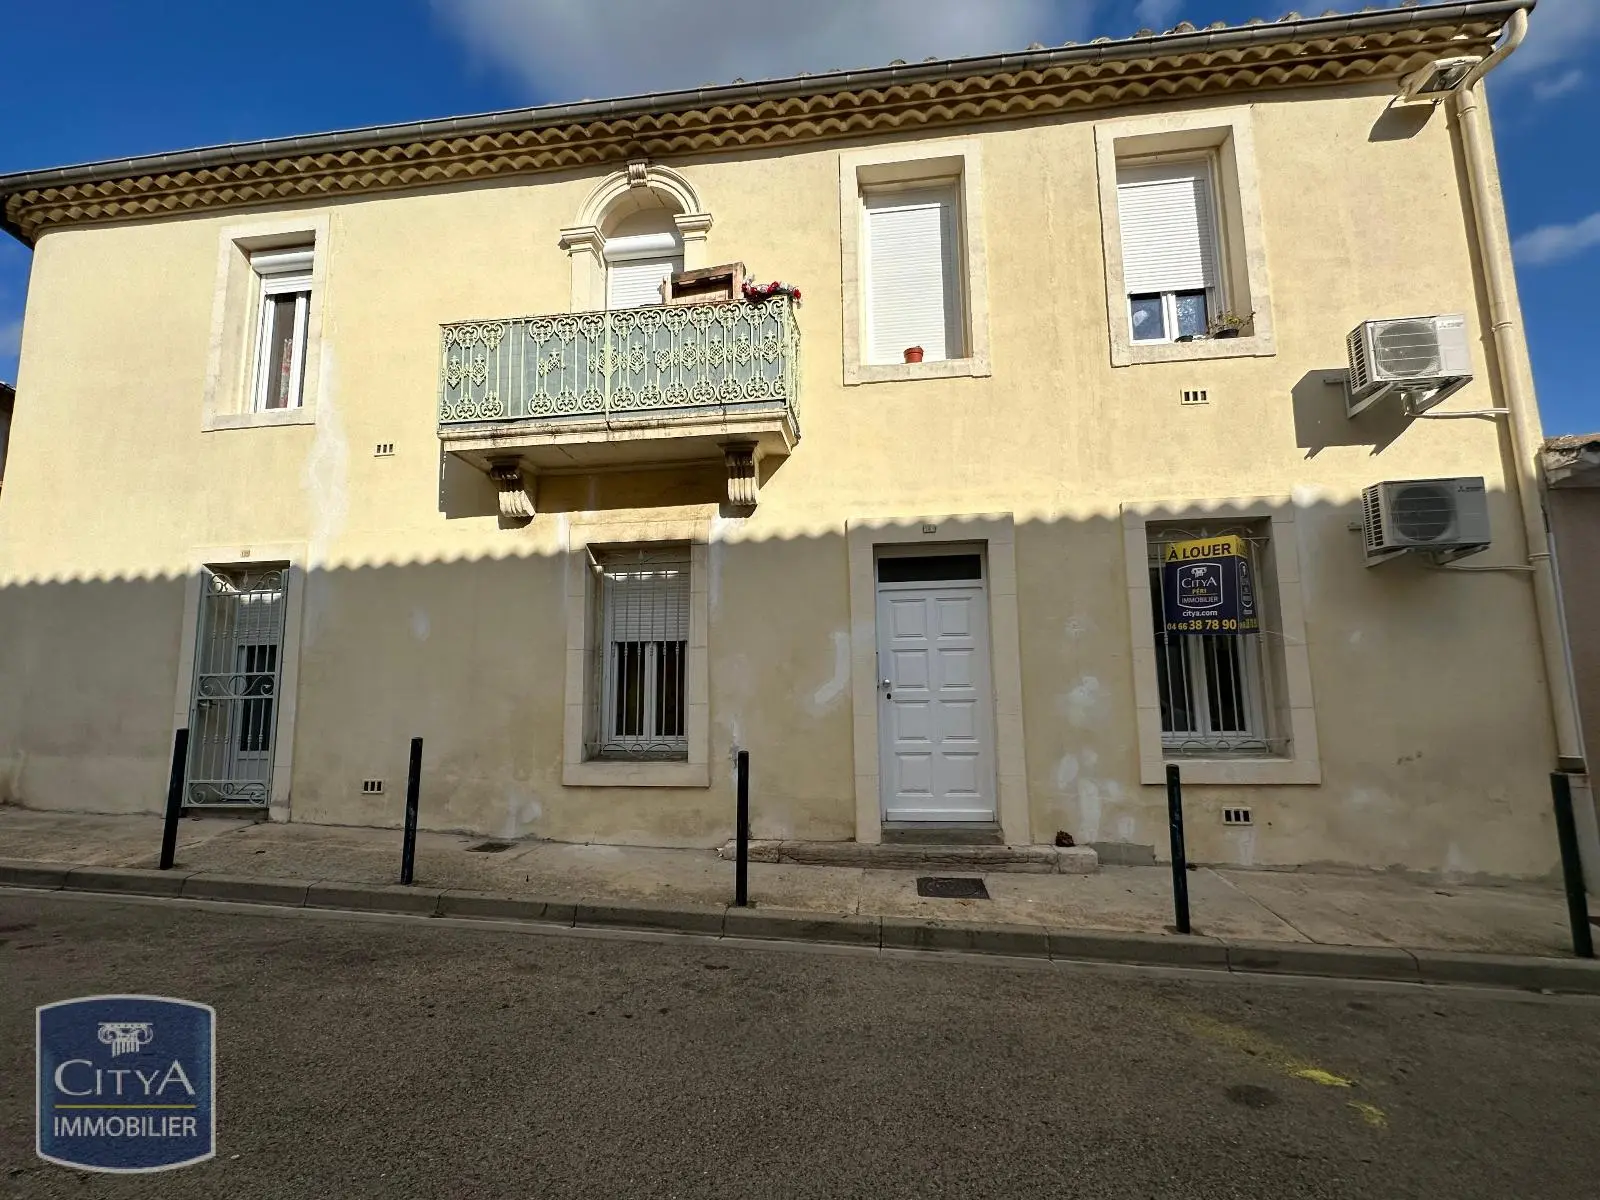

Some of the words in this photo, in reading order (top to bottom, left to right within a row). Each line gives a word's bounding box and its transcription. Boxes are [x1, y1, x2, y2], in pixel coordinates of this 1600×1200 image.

[1168, 547, 1179, 561] À
[1182, 543, 1231, 559] LOUER
[1182, 609, 1218, 618] citya.com
[1178, 622, 1188, 630] 66
[1189, 620, 1202, 630] 38
[1205, 619, 1219, 630] 78
[1222, 619, 1237, 630] 90
